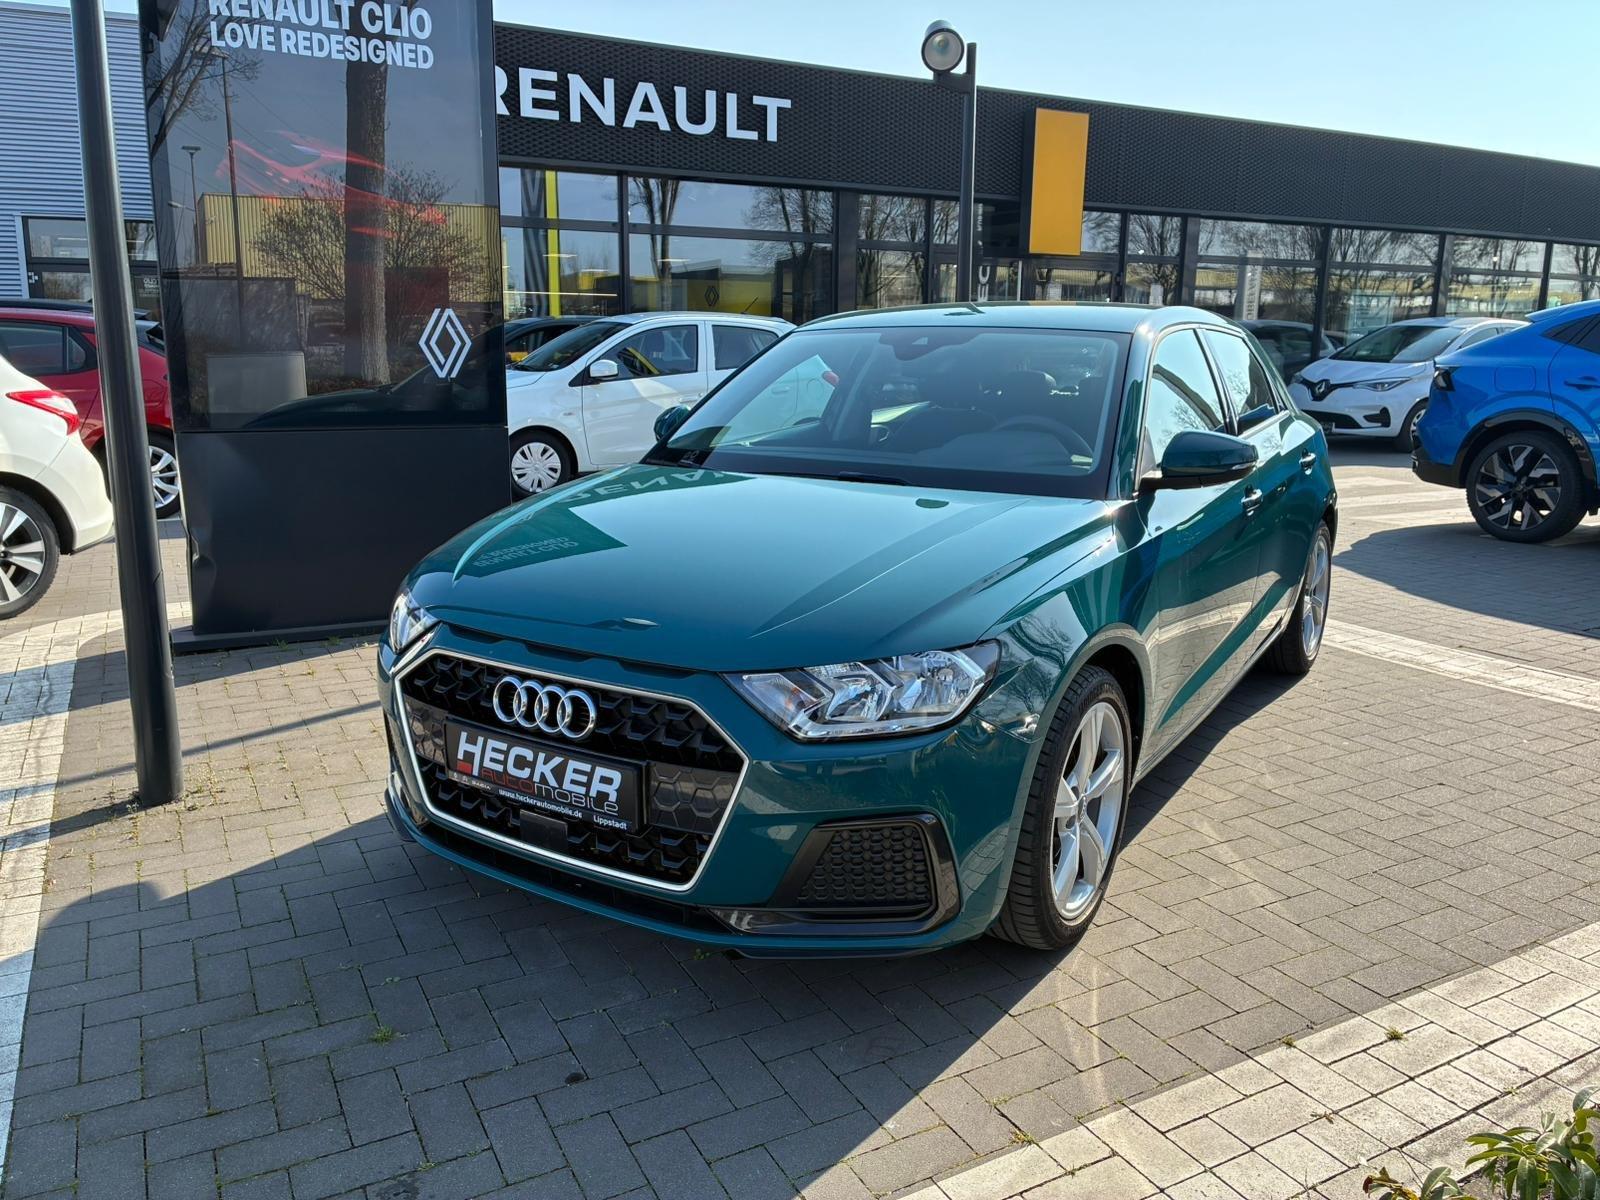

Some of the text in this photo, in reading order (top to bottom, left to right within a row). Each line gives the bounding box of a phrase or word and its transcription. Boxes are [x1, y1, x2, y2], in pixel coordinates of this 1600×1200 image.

[361, 1, 433, 40] CLIO
[209, 21, 434, 70] LOVE REDESIGNED
[457, 731, 622, 802] HECKER
[498, 788, 583, 819] www.heckerautomobile.de
[593, 814, 628, 830] Lippstadt
